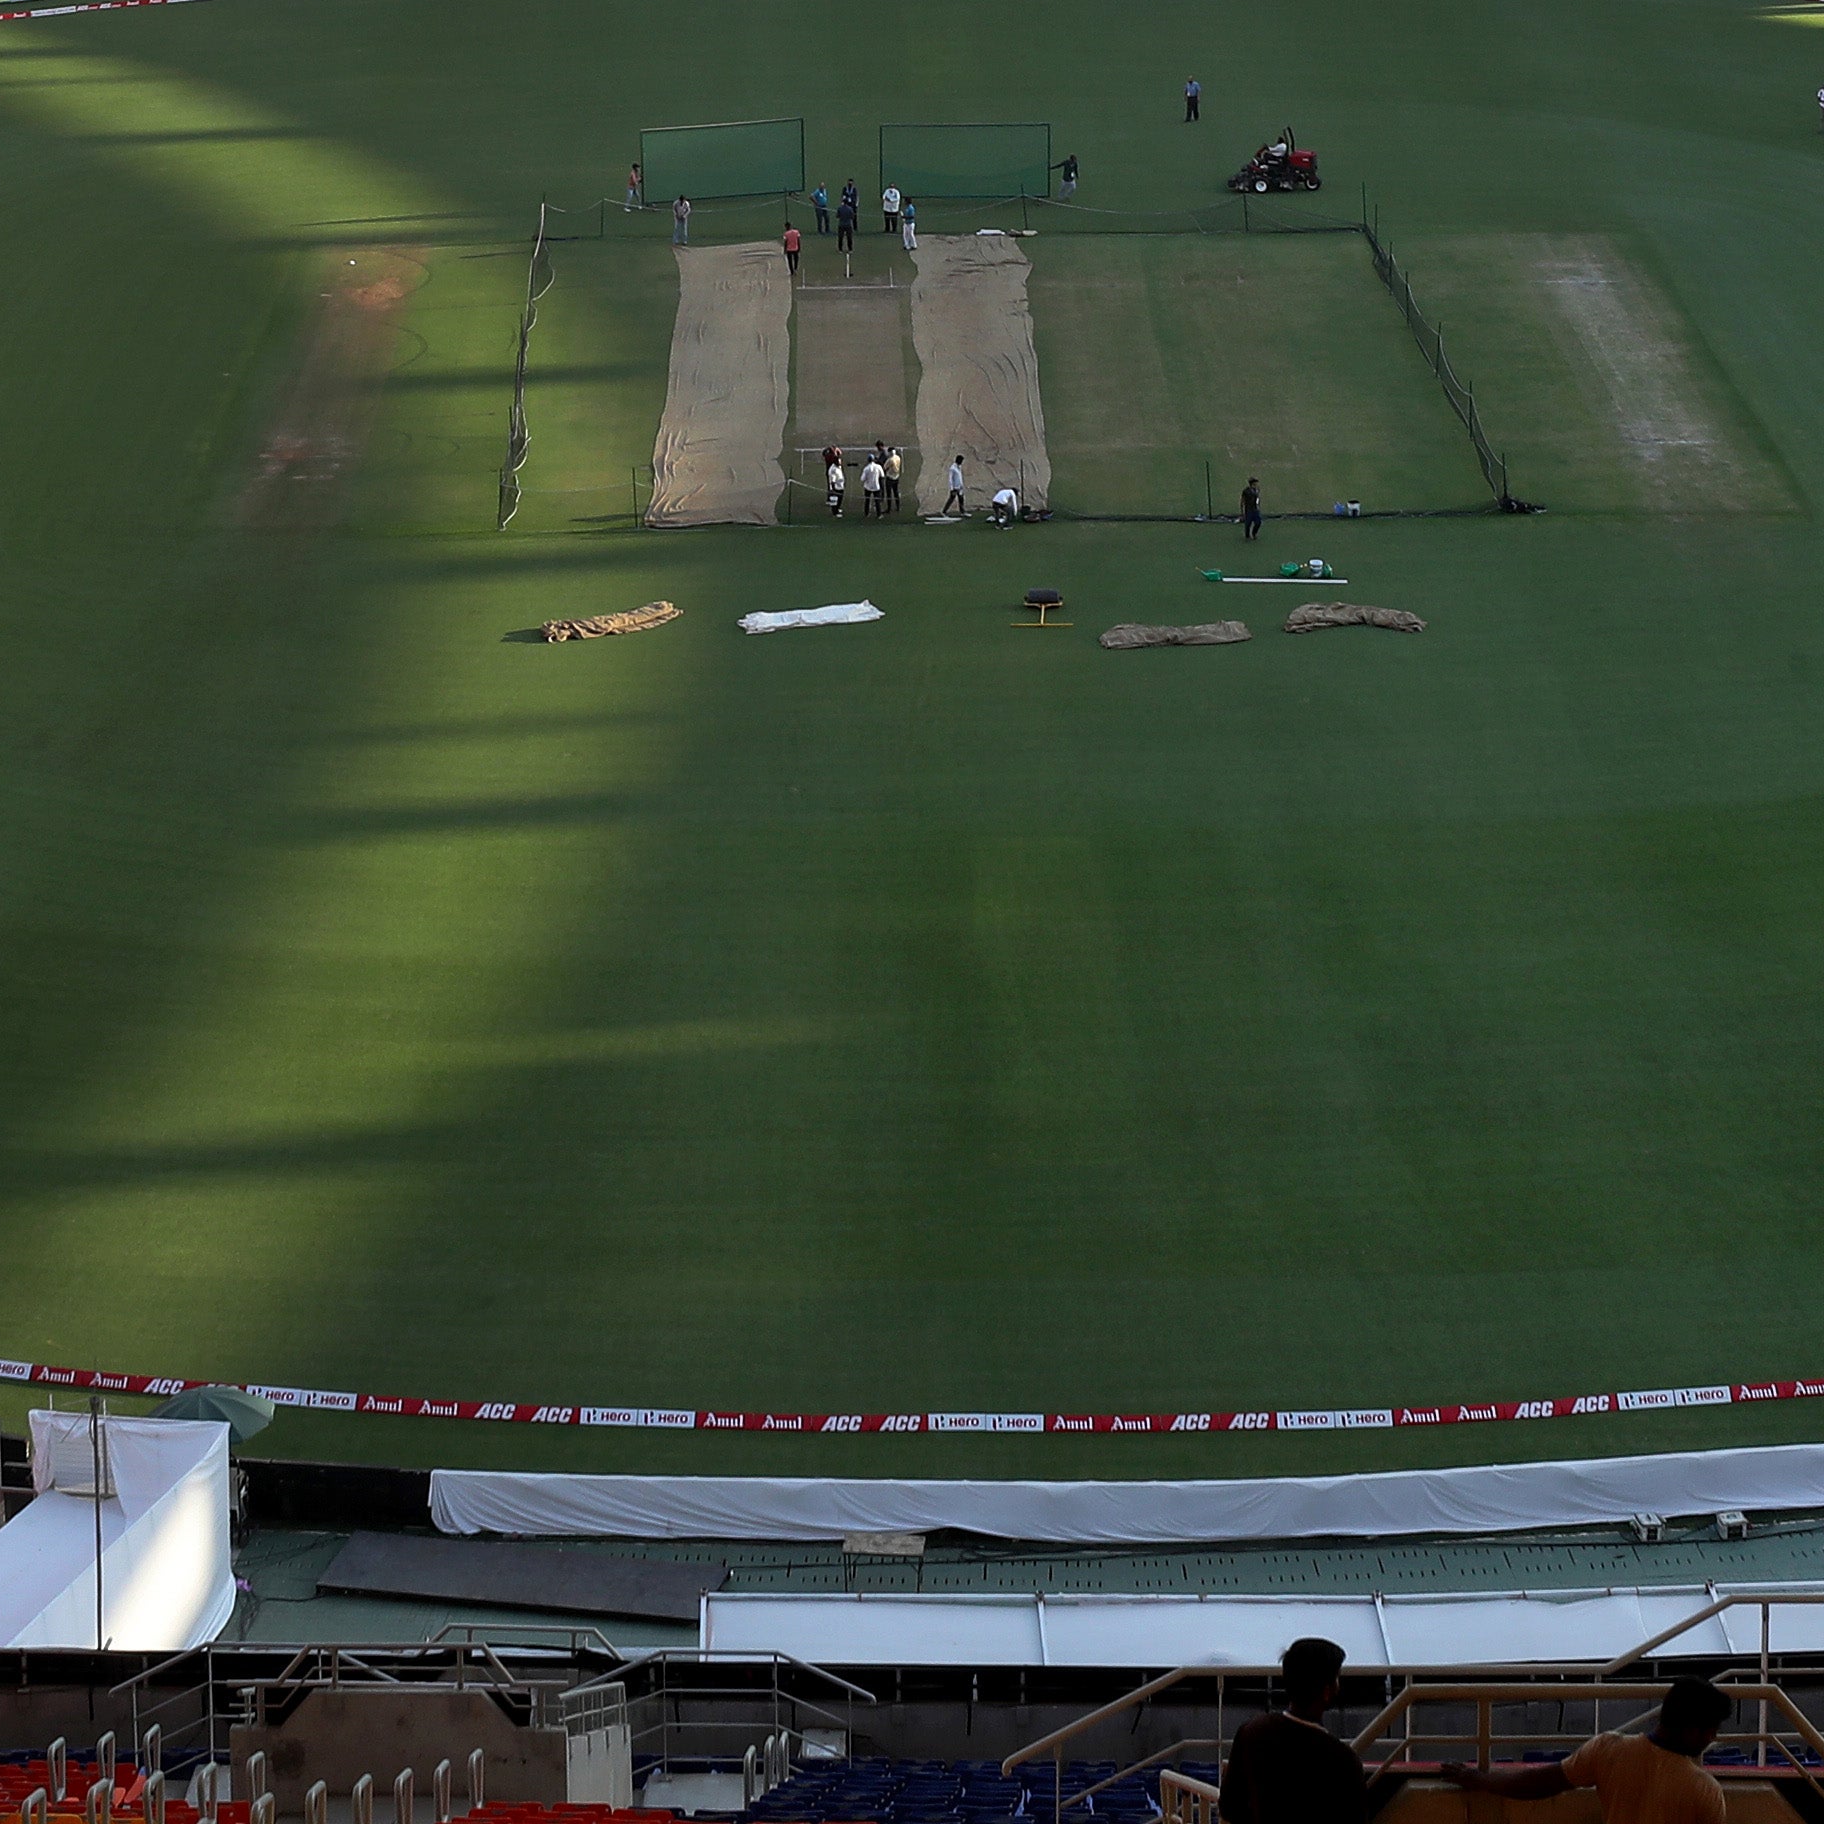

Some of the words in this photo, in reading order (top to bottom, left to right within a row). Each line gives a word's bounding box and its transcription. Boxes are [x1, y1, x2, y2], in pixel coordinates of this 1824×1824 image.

[363, 1394, 403, 1413] Amul
[474, 1403, 516, 1421] ACC
[1514, 1401, 1553, 1419] ACC
